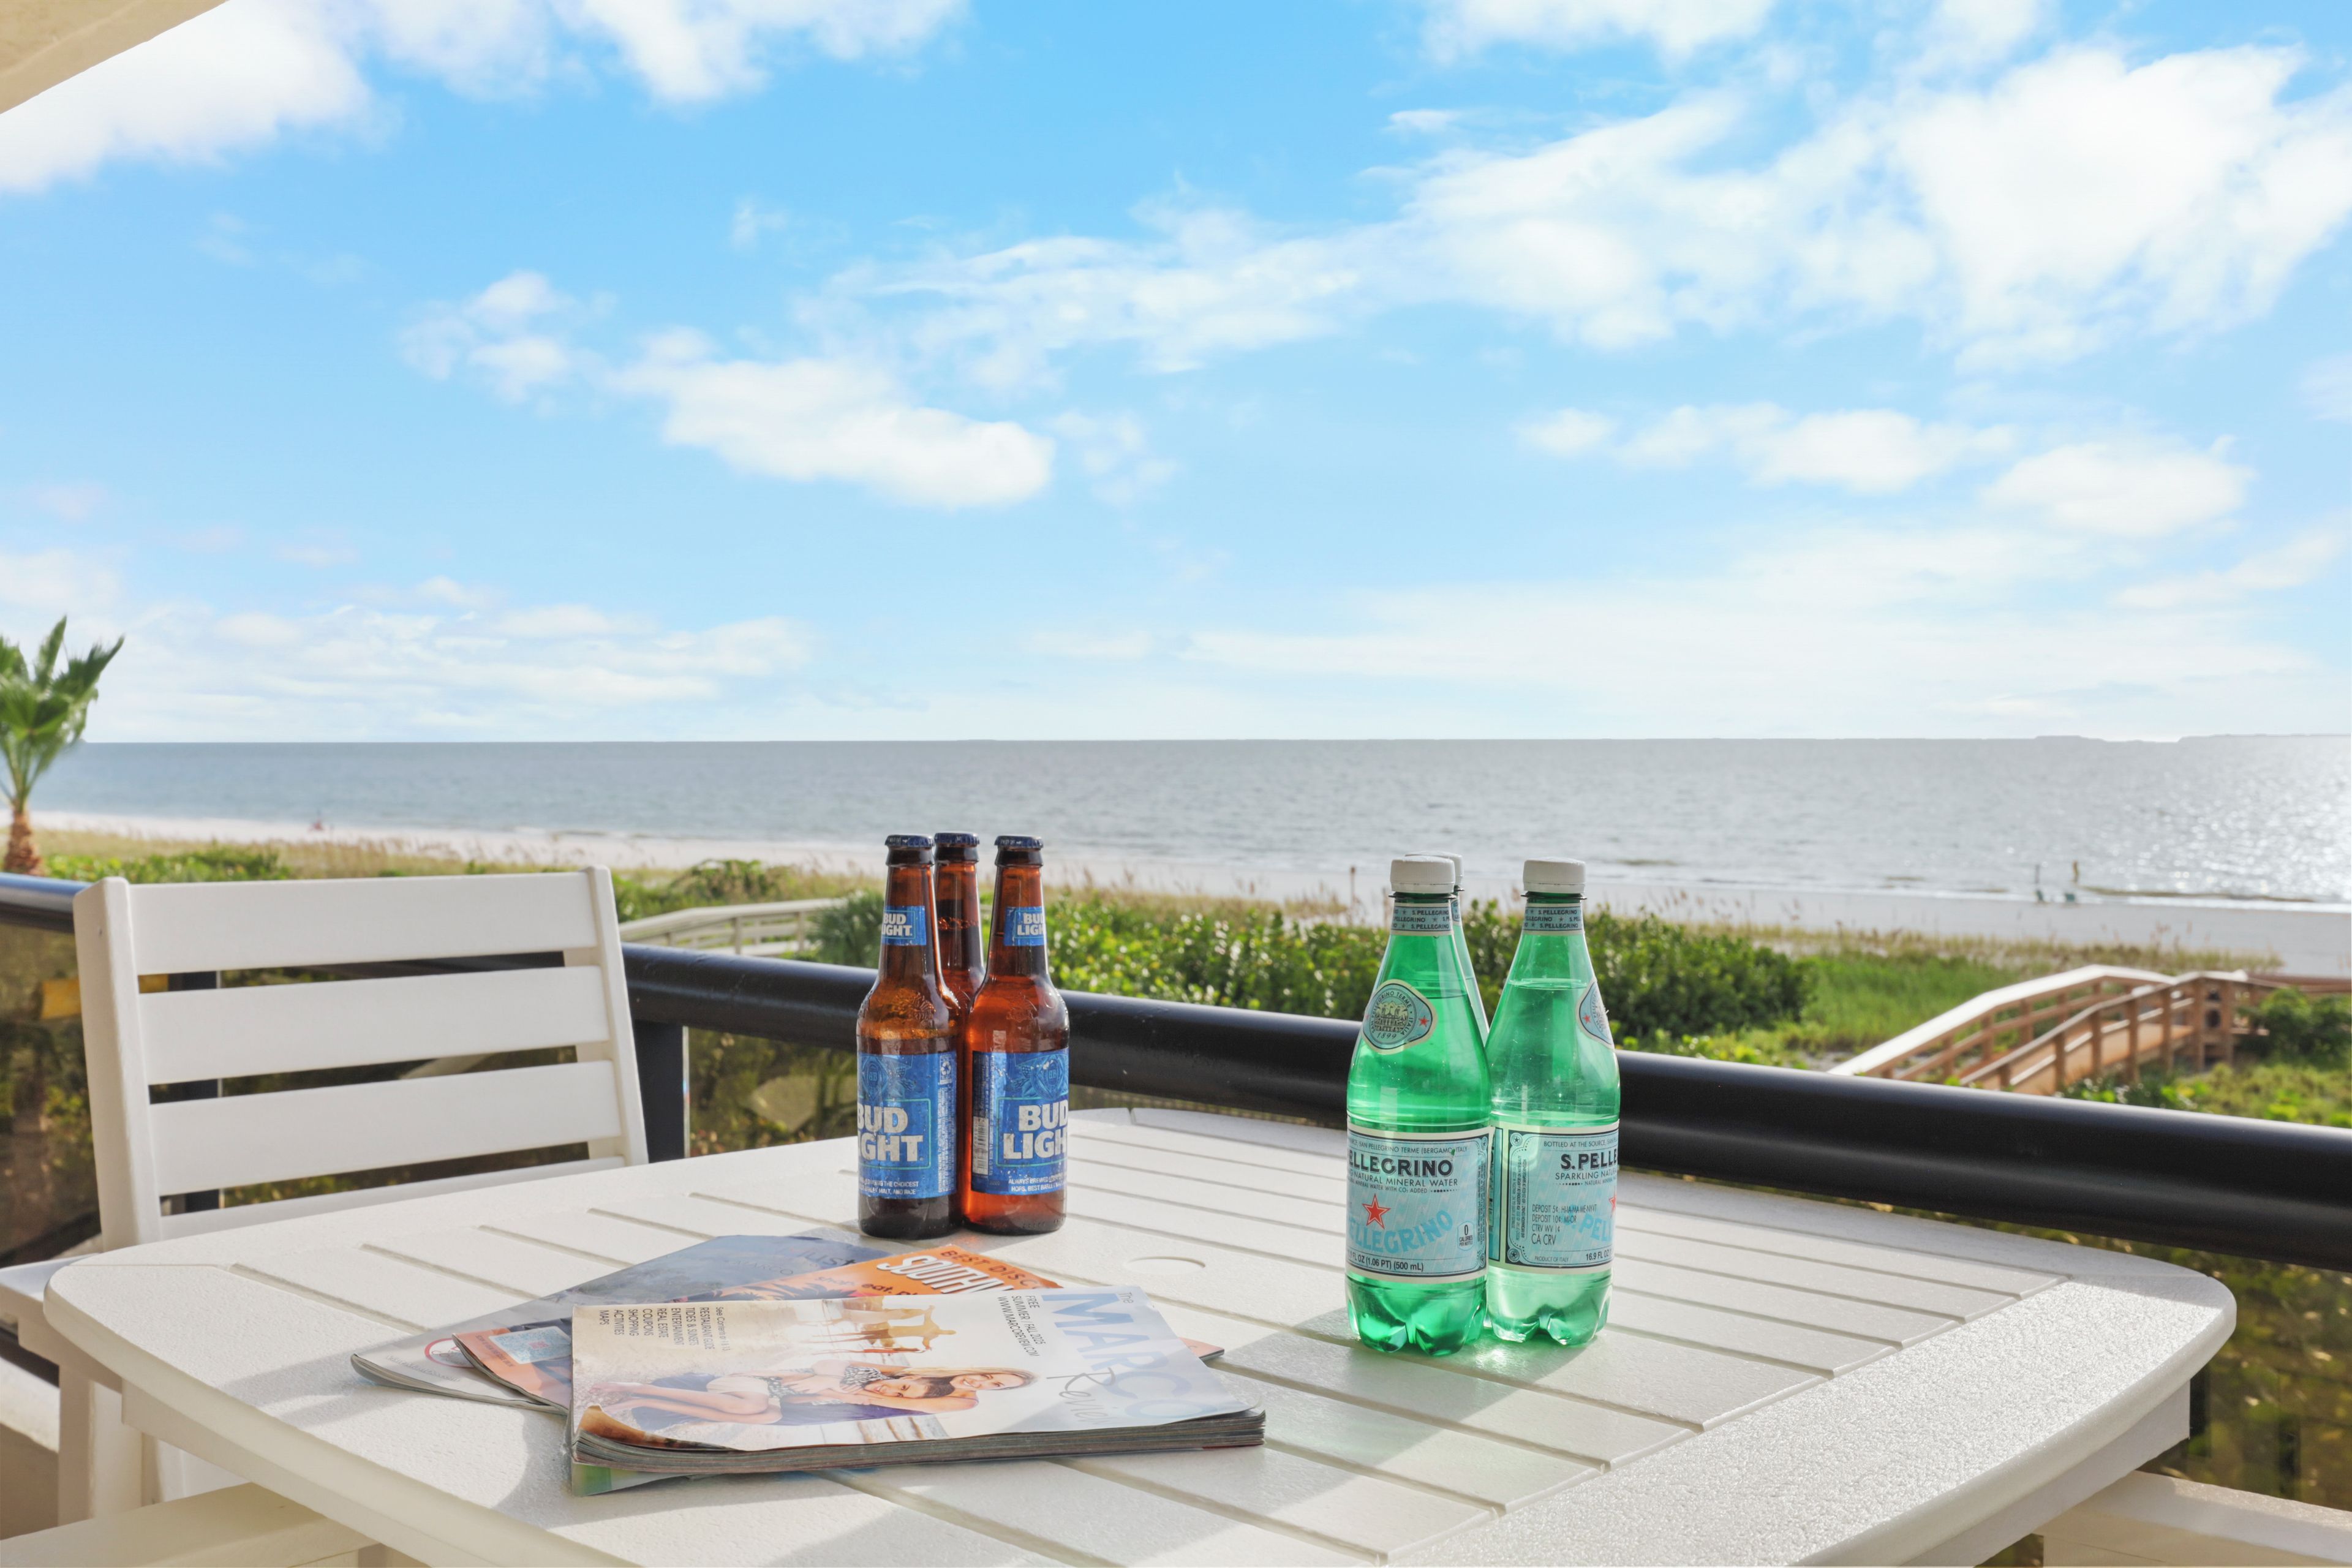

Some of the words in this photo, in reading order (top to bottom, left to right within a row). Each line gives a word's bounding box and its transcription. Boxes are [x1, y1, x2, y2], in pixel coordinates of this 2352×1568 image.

[882, 925, 913, 937] IGHT
[1017, 925, 1045, 936] LIGH
[1396, 991, 1412, 1009] TERME
[1377, 1031, 1397, 1040] 1899
[1400, 1017, 1414, 1036] ITALIA
[857, 1104, 908, 1134] BUD
[1019, 1100, 1069, 1131] BUD
[857, 1133, 924, 1162] IGHT
[1003, 1127, 1068, 1159] LIGH
[1349, 1149, 1454, 1178] ELLEGRINO
[1561, 1148, 1617, 1170] S.PELLE
[1354, 1170, 1382, 1184] NATURAL
[1386, 1178, 1425, 1187] MINERAL
[1429, 1178, 1458, 1187] WATER
[1555, 1170, 1599, 1180] SPARKLING
[1532, 1204, 1551, 1213] DEPOSIT
[1532, 1213, 1551, 1223] DEPOSIT
[1349, 1210, 1453, 1254] ELLEGRINO
[1464, 1224, 1469, 1235] 0
[1531, 1224, 1544, 1232] CTRV
[1531, 1233, 1542, 1245] CA
[1544, 1234, 1556, 1245] CRV
[1357, 1254, 1365, 1264] OZ
[1366, 1256, 1379, 1267] (1.06
[1381, 1259, 1392, 1270] PT)
[1393, 1261, 1408, 1270] (500
[1410, 1262, 1424, 1273] mL)
[1597, 1251, 1603, 1259] FL
[940, 1250, 990, 1266] BEST
[989, 1265, 1042, 1289] DISC
[1025, 1295, 1040, 1308] FREE
[1119, 1292, 1134, 1305] The
[599, 1310, 609, 1325] MAPS
[614, 1310, 624, 1335] ACTIVITIES
[628, 1309, 639, 1336] SHOPPING
[643, 1308, 654, 1336] COUPONS
[657, 1308, 667, 1322] REAL
[685, 1308, 696, 1322] TIDES
[699, 1307, 712, 1338] RESTAURANT
[1011, 1295, 1030, 1320] SUMMER
[1024, 1324, 1038, 1333] FALL
[658, 1322, 669, 1338] ESTATE
[671, 1308, 684, 1345] ENTERTAINMENT
[997, 1296, 1041, 1357] WWW.MARCOREVIEW.COM
[1041, 1293, 1218, 1419] MARCO
